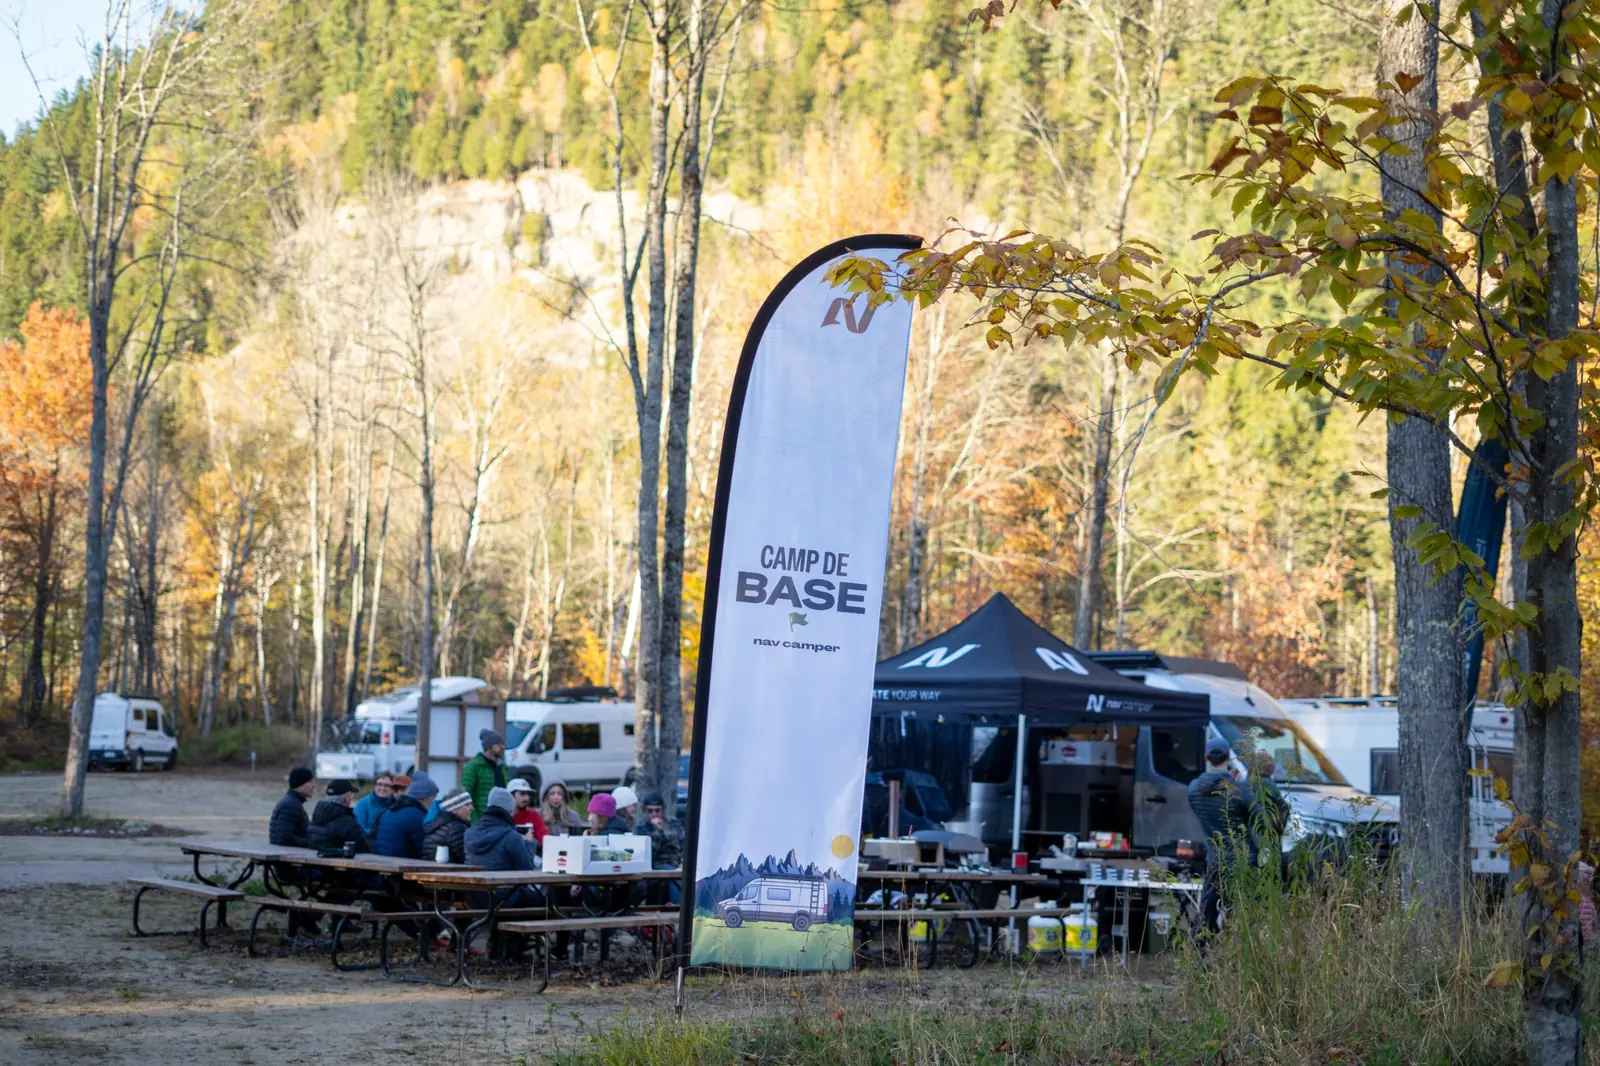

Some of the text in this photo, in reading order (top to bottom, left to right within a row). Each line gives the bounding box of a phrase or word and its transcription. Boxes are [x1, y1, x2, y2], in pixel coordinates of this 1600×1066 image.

[760, 544, 850, 577] CAMP DE
[735, 571, 868, 615] BASE
[753, 637, 841, 653] nav camper
[891, 689, 918, 701] YOUR
[919, 689, 942, 701] WAY
